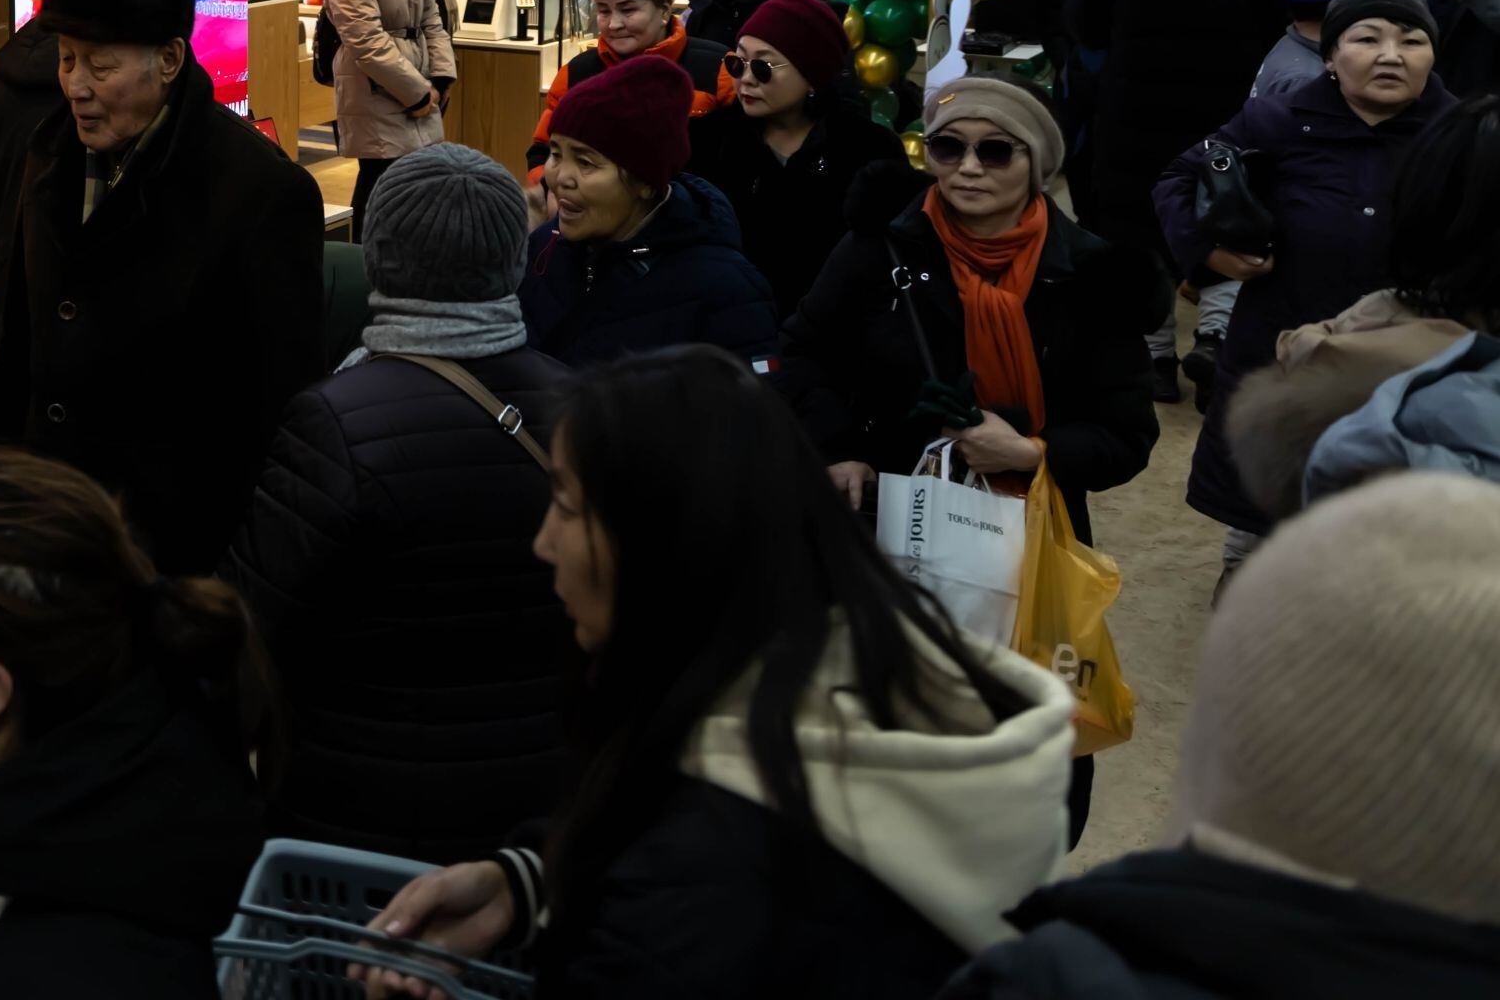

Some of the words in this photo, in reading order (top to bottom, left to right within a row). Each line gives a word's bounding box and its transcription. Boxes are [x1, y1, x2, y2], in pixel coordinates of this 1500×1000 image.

[909, 488, 926, 543] JOURS
[947, 512, 971, 526] TOUS
[980, 520, 1004, 536] JOURS
